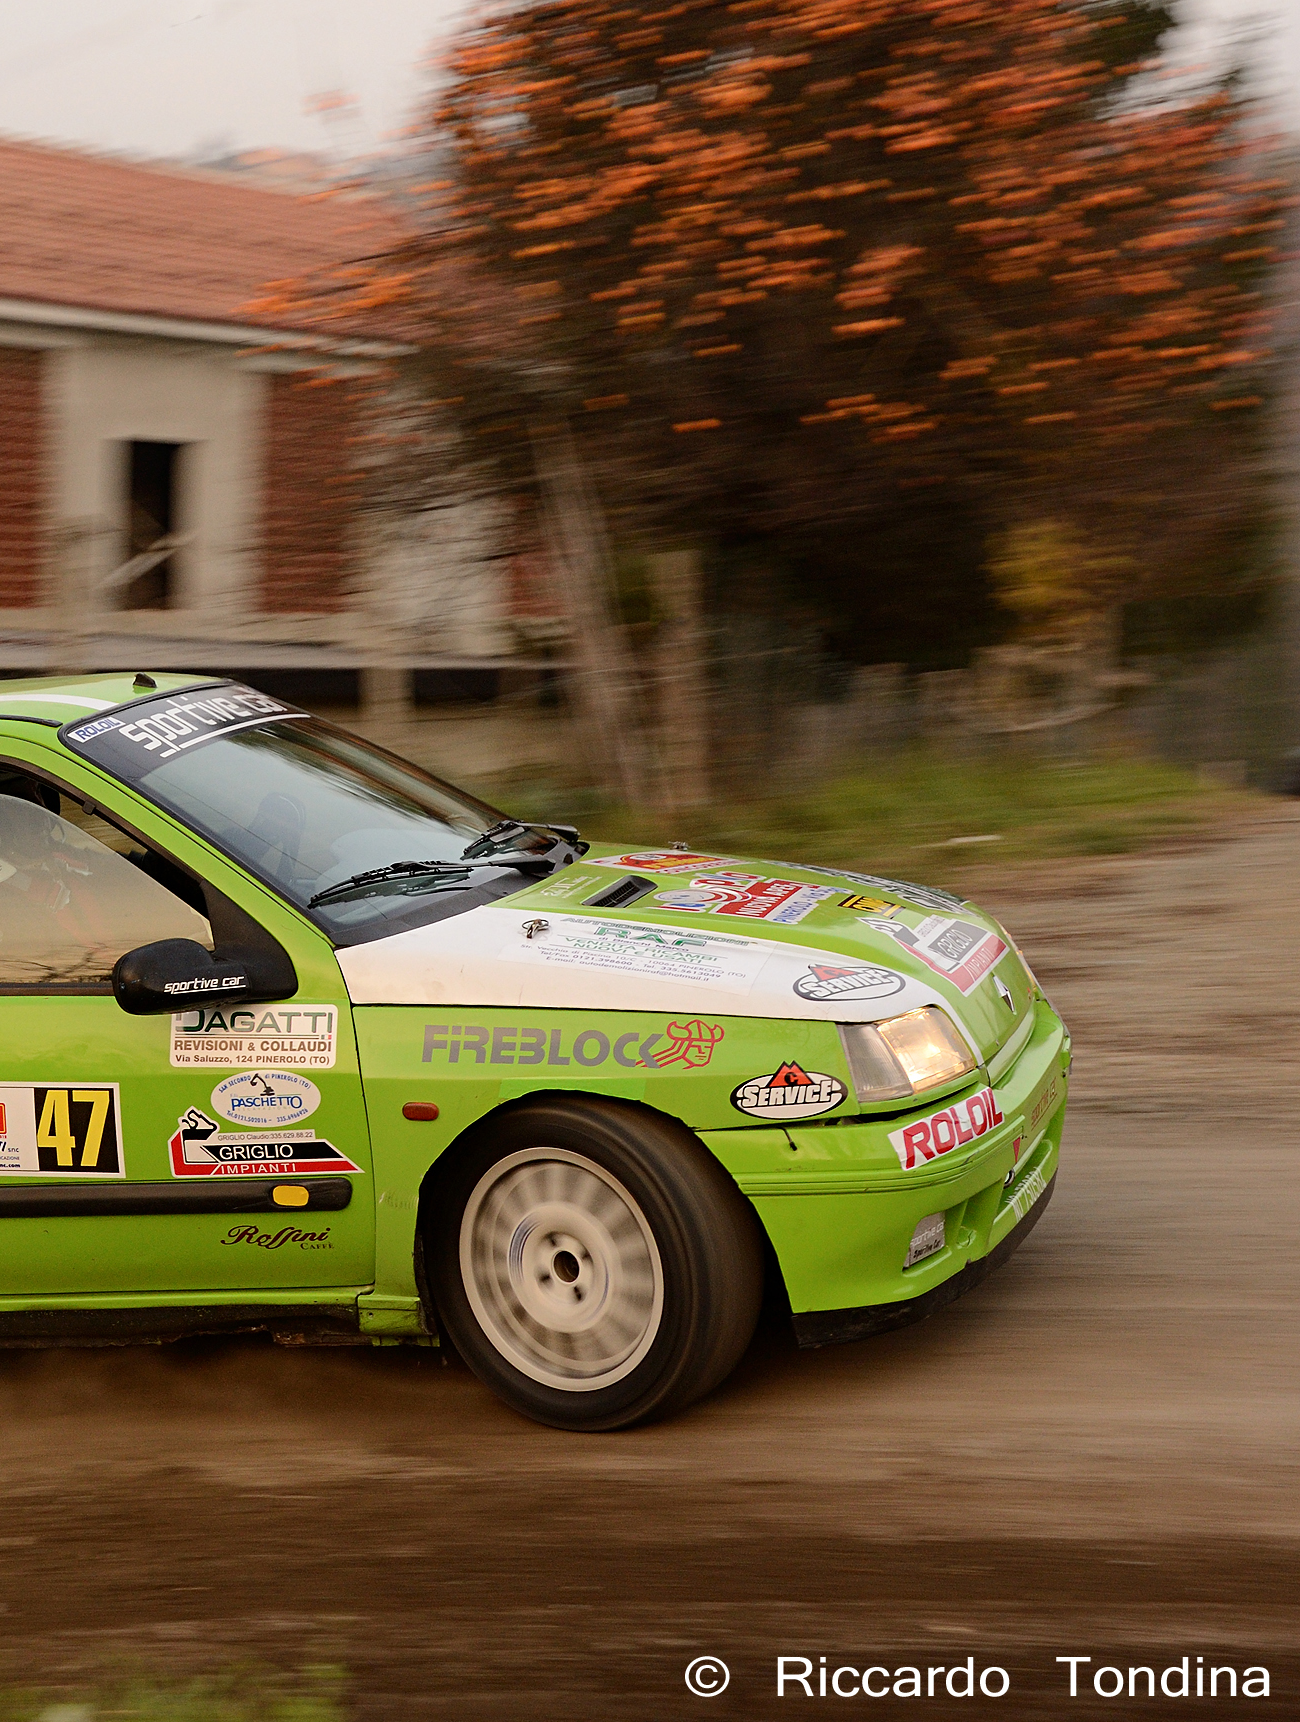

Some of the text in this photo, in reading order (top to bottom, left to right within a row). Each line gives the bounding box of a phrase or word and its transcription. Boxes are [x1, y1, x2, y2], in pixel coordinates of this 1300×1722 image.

[76, 718, 121, 741] ROLOIL
[119, 696, 253, 758] sportive
[594, 926, 707, 947] RAF
[565, 937, 718, 961] VENDITA RICAMBI
[573, 943, 627, 954] NUOVI
[652, 953, 702, 963] USATI
[164, 976, 245, 995] sportive car
[801, 969, 895, 998] SERVICE
[174, 1040, 332, 1052] REVISIONI & COLLAUDI
[193, 1055, 232, 1064] Saluzzo,
[236, 1055, 253, 1063] 124
[256, 1056, 307, 1064] PINEROLO
[309, 1056, 330, 1065] (TO)
[218, 1085, 228, 1093] SAN
[228, 1075, 252, 1087] SECONDO
[271, 1074, 298, 1083] PINEROLO
[299, 1079, 312, 1089] (TO)
[742, 1080, 832, 1107] SERVICE
[231, 1096, 302, 1111] PASCHETTO
[37, 1089, 111, 1167] 47
[903, 1088, 1003, 1170] ROLOIL
[219, 1144, 294, 1160] GRIGLIO
[221, 1163, 296, 1174] IMPIANTI
